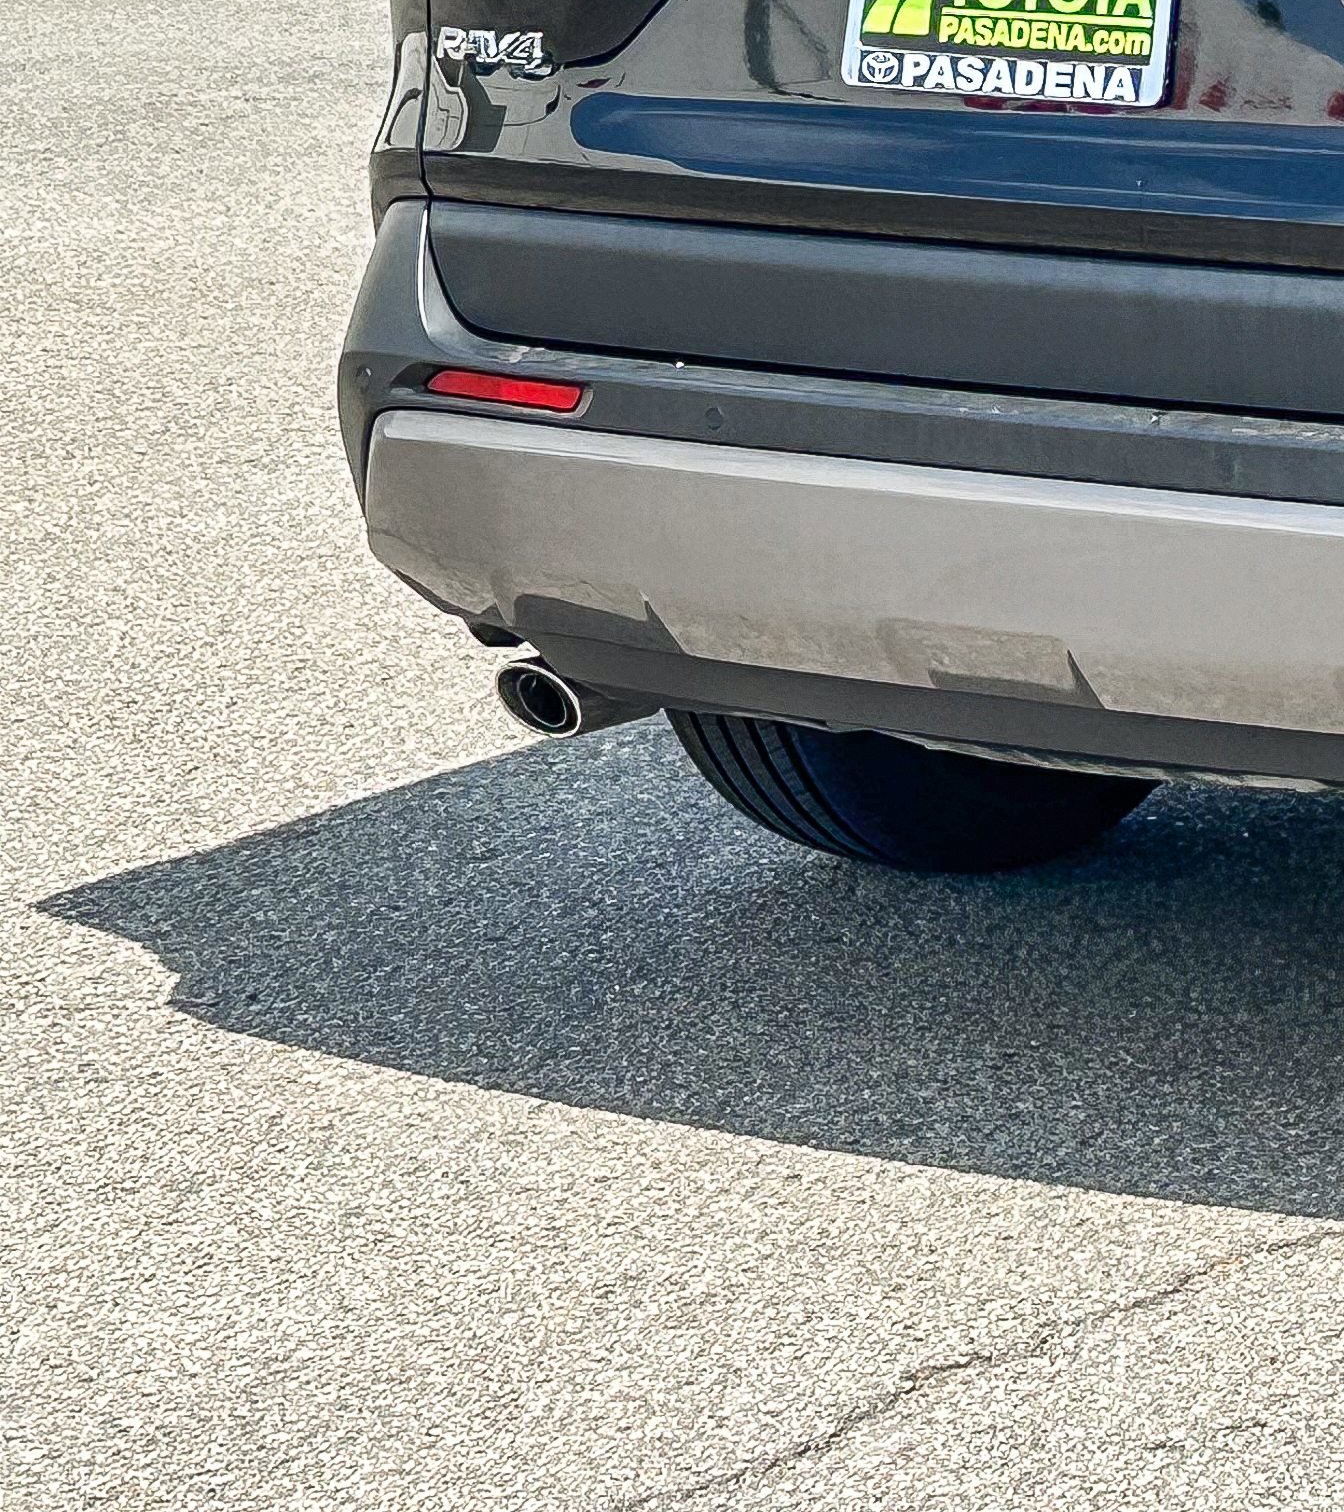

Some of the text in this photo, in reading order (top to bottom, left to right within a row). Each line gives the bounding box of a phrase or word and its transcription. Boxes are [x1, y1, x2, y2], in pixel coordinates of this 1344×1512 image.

[437, 26, 544, 70] RAV4
[938, 14, 1151, 56] PASADENA.com
[900, 53, 1137, 103] PASADENA
